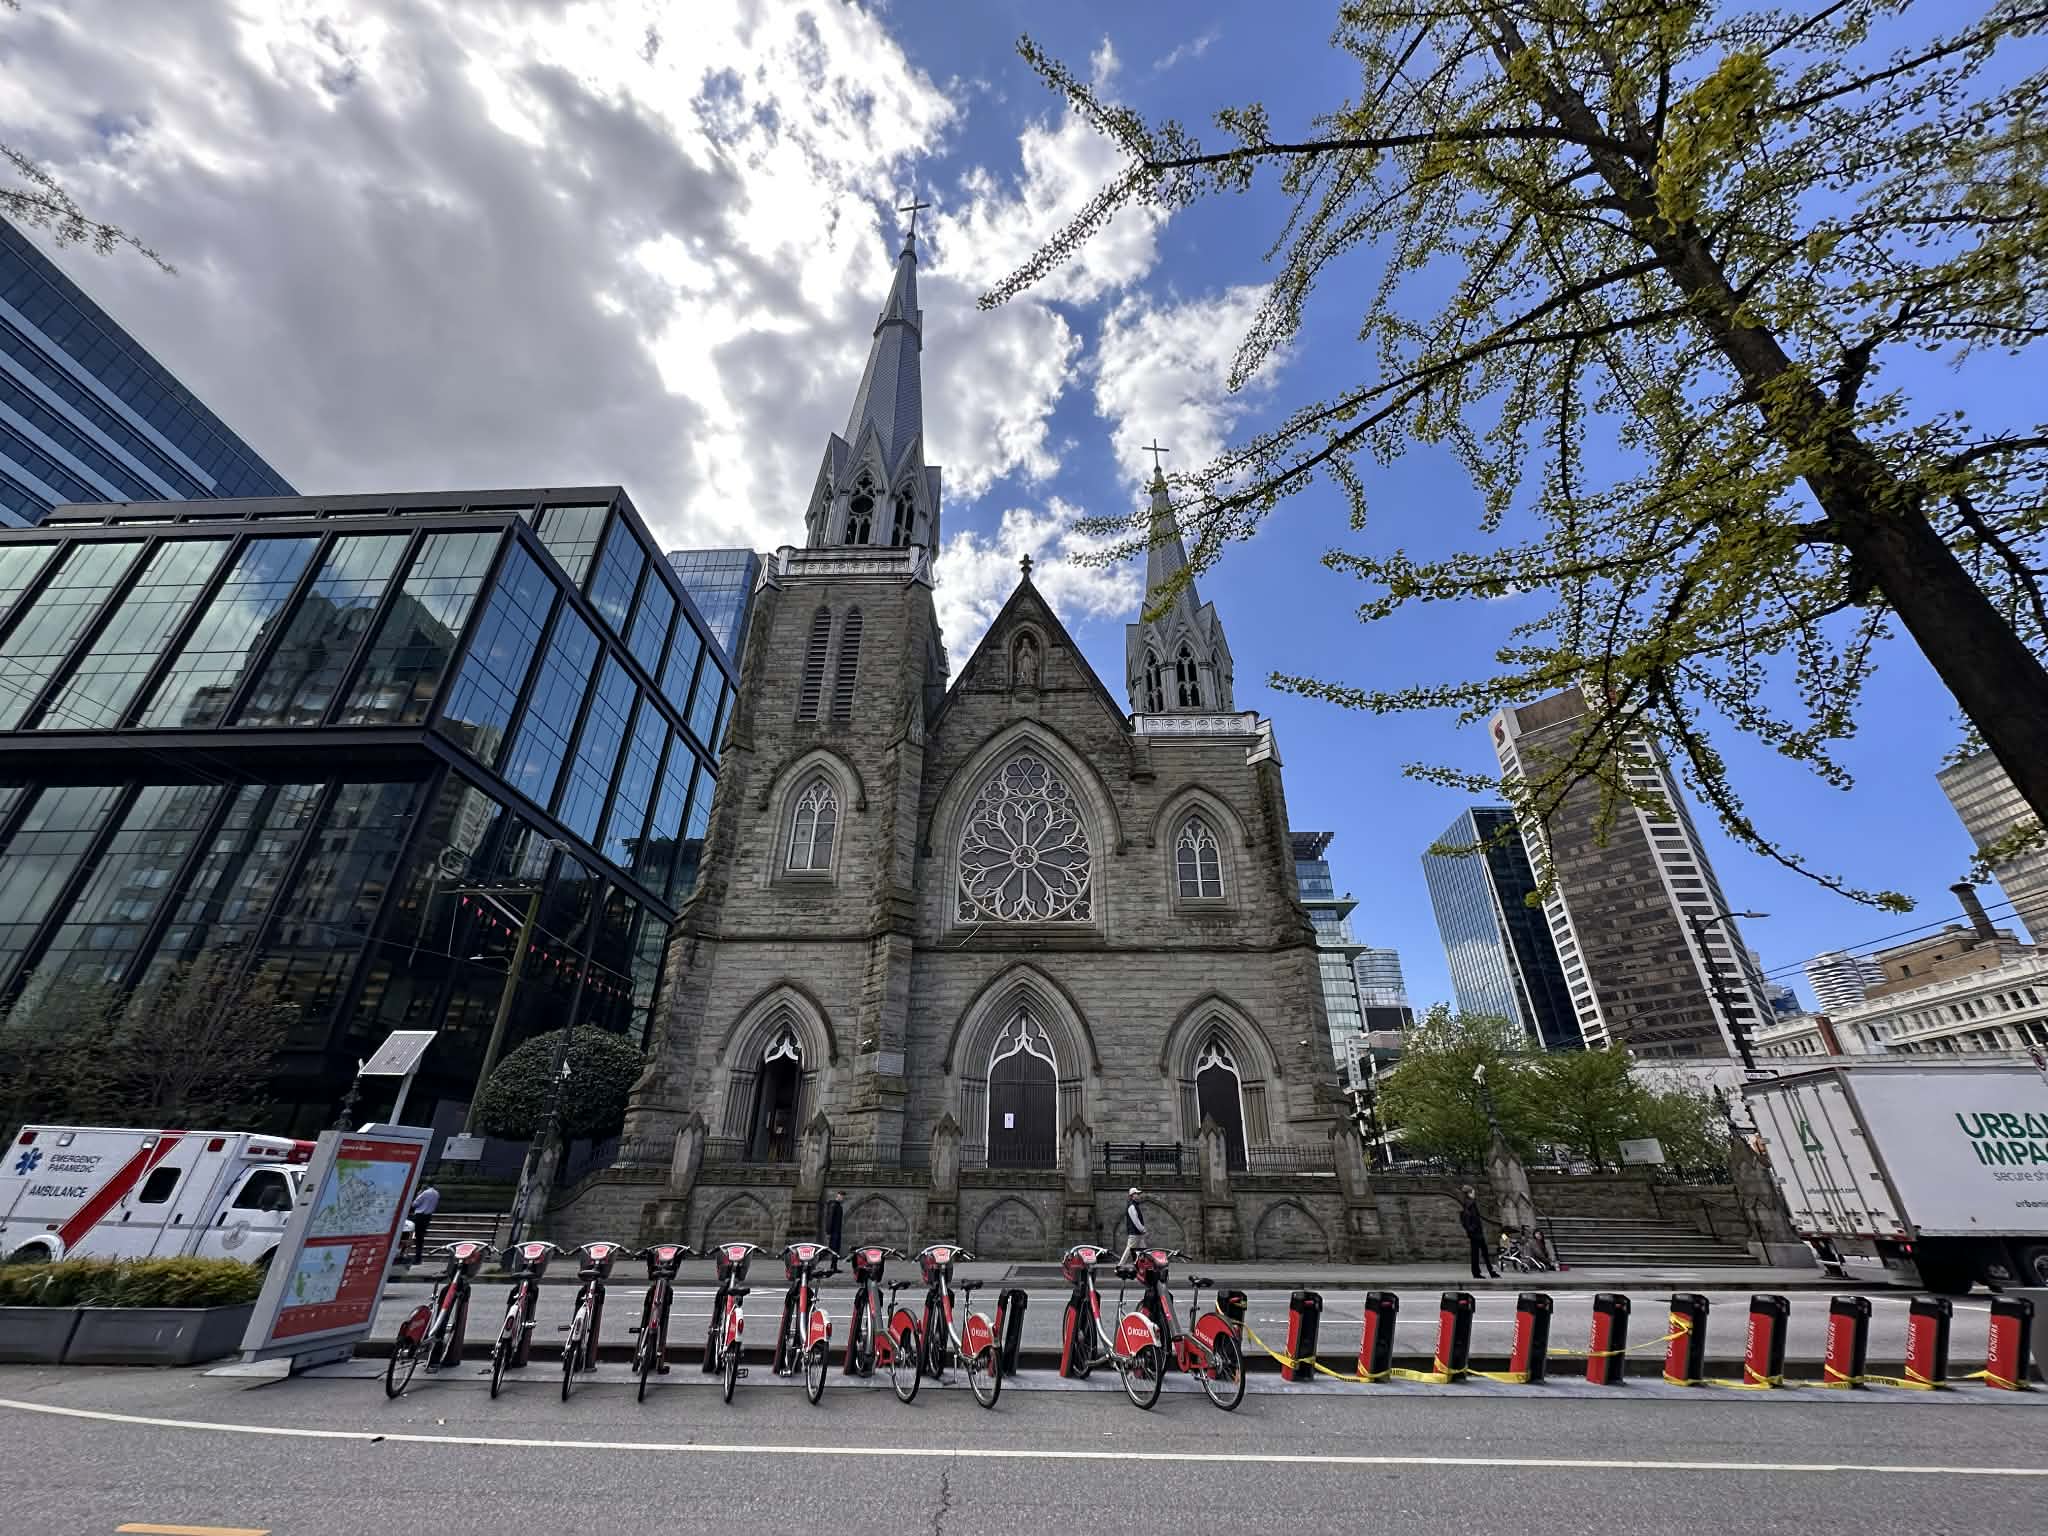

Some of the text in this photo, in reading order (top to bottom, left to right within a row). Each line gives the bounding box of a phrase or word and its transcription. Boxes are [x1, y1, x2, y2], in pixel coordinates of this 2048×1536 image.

[1971, 1140, 2048, 1166] IMPA
[49, 1154, 102, 1164] EMERGENCY
[48, 1163, 95, 1173] PARAMEDIC
[29, 1185, 88, 1198] AMBULANCE
